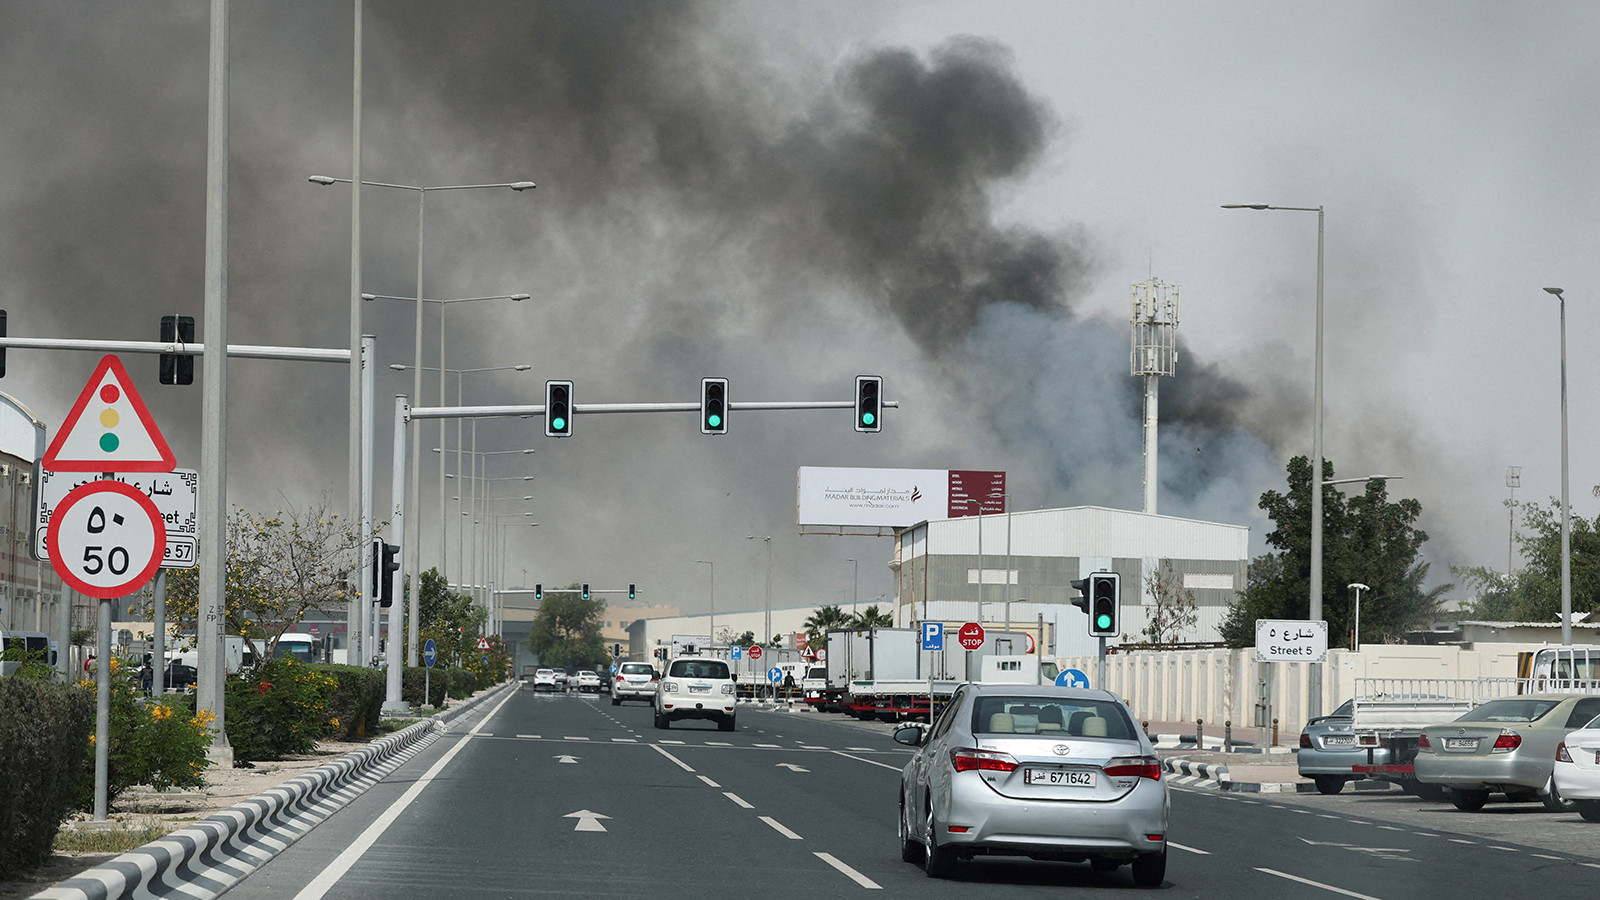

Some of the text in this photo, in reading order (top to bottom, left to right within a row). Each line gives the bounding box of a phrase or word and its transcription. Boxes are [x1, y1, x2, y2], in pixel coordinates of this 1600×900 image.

[86, 506, 125, 534] ٥٠
[175, 545, 191, 559] 57
[83, 546, 130, 575] 50
[926, 625, 939, 641] P
[964, 627, 978, 635] قف
[1269, 629, 1314, 641] شارع ٥
[733, 646, 740, 656] P
[1270, 645, 1313, 656] Street 5
[1050, 771, 1091, 785] 671642
